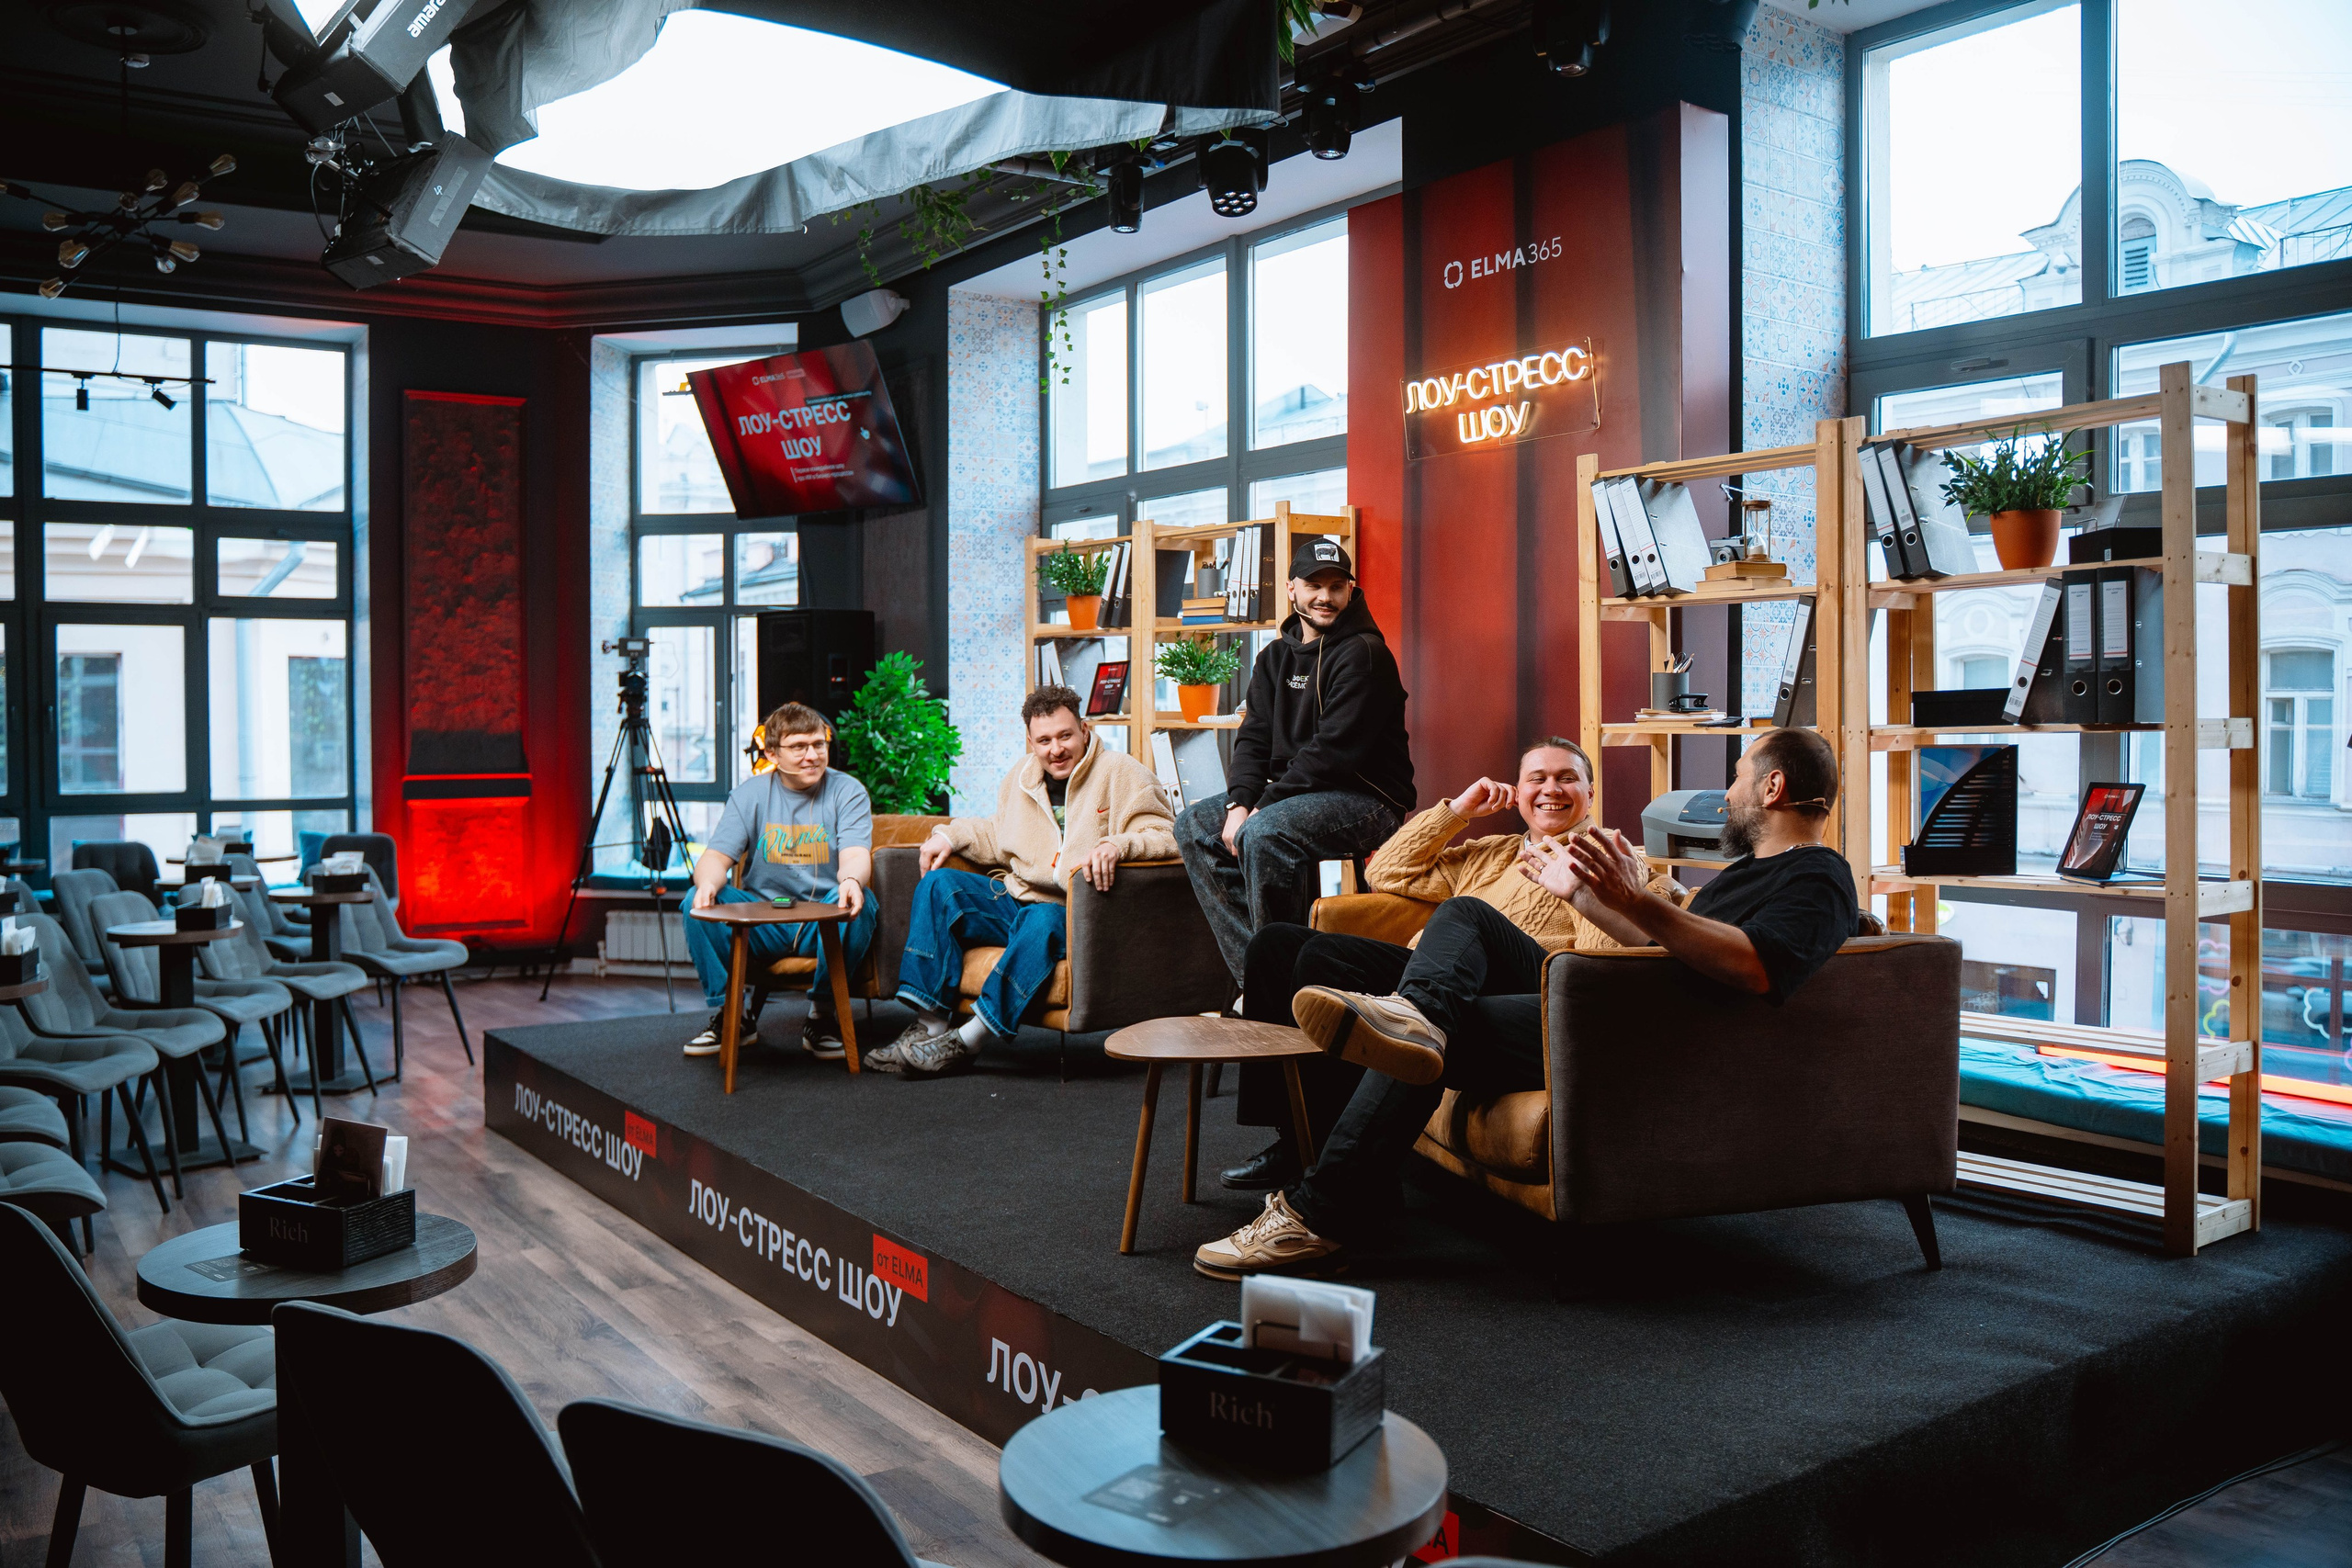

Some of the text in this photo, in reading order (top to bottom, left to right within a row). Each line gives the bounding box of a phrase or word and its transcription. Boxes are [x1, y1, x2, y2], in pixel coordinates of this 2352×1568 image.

[1471, 236, 1562, 279] ELMA365
[1406, 346, 1589, 413] ЛОУ-СТРЕСС
[738, 400, 852, 436] ЛОУ-СТРЕСС
[1458, 400, 1530, 443] ШОУ
[781, 435, 822, 460] ШОУ
[2086, 813, 2121, 822] ЛОУ-СТРЕСС
[514, 1082, 643, 1181] ЛОУ-СТРЕСС ШОУ
[269, 1216, 309, 1243] Rich
[689, 1178, 903, 1326] ЛОУ-СТРЕСС ШОУ
[876, 1252, 923, 1289] от ELMA
[987, 1337, 1100, 1415] ЛОУ-
[1210, 1391, 1273, 1430] Rich
